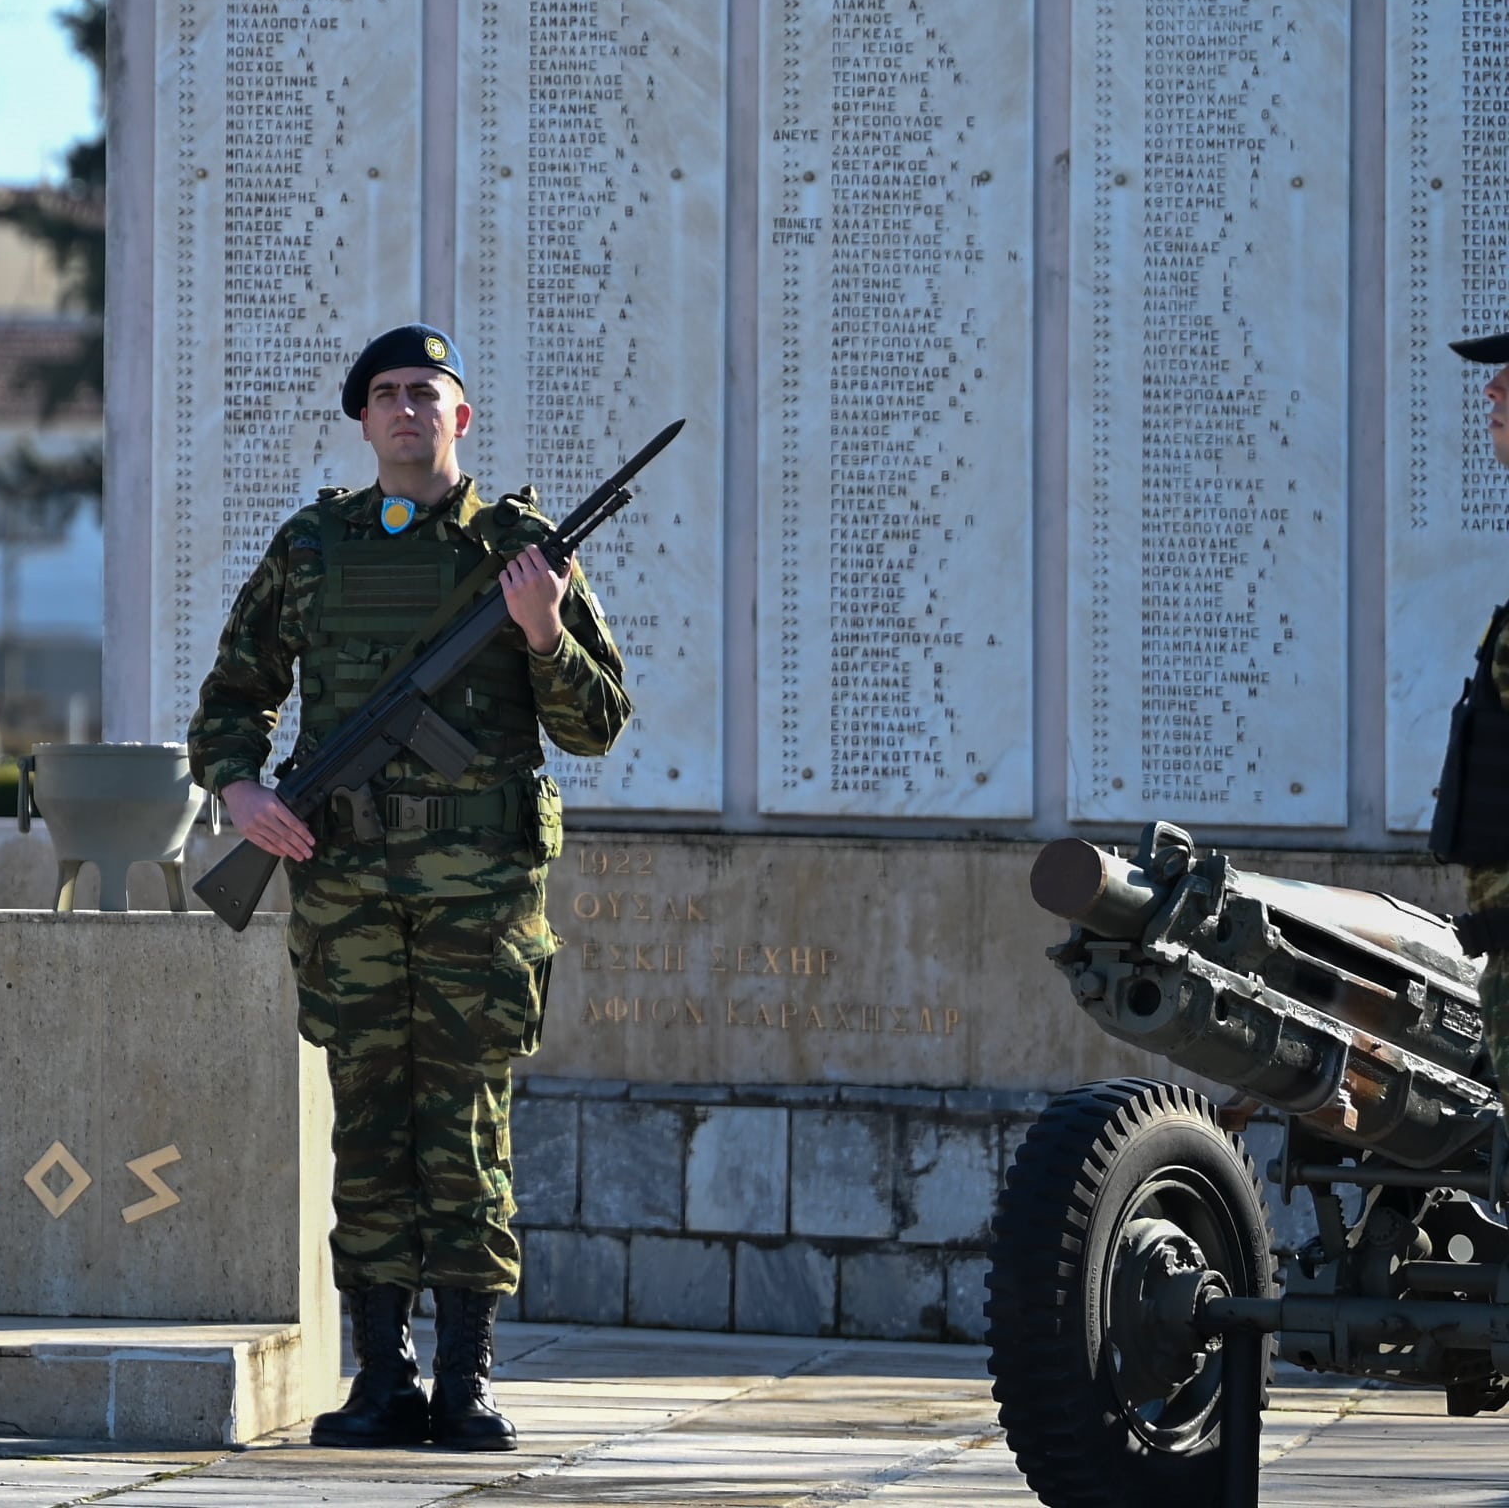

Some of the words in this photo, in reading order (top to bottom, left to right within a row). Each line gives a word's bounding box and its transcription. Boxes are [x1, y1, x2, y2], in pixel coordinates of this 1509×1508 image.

[579, 847, 654, 876] 1922
[573, 891, 710, 922] ΟΥΣΑΚ
[581, 942, 686, 972] ΕΣΚΗ
[709, 946, 839, 975] ΣΕΧΗΡ
[580, 996, 706, 1026] ΑΦΙΟΝ
[725, 1000, 961, 1035] ΚΑΡΑΧΗΣΑΡ
